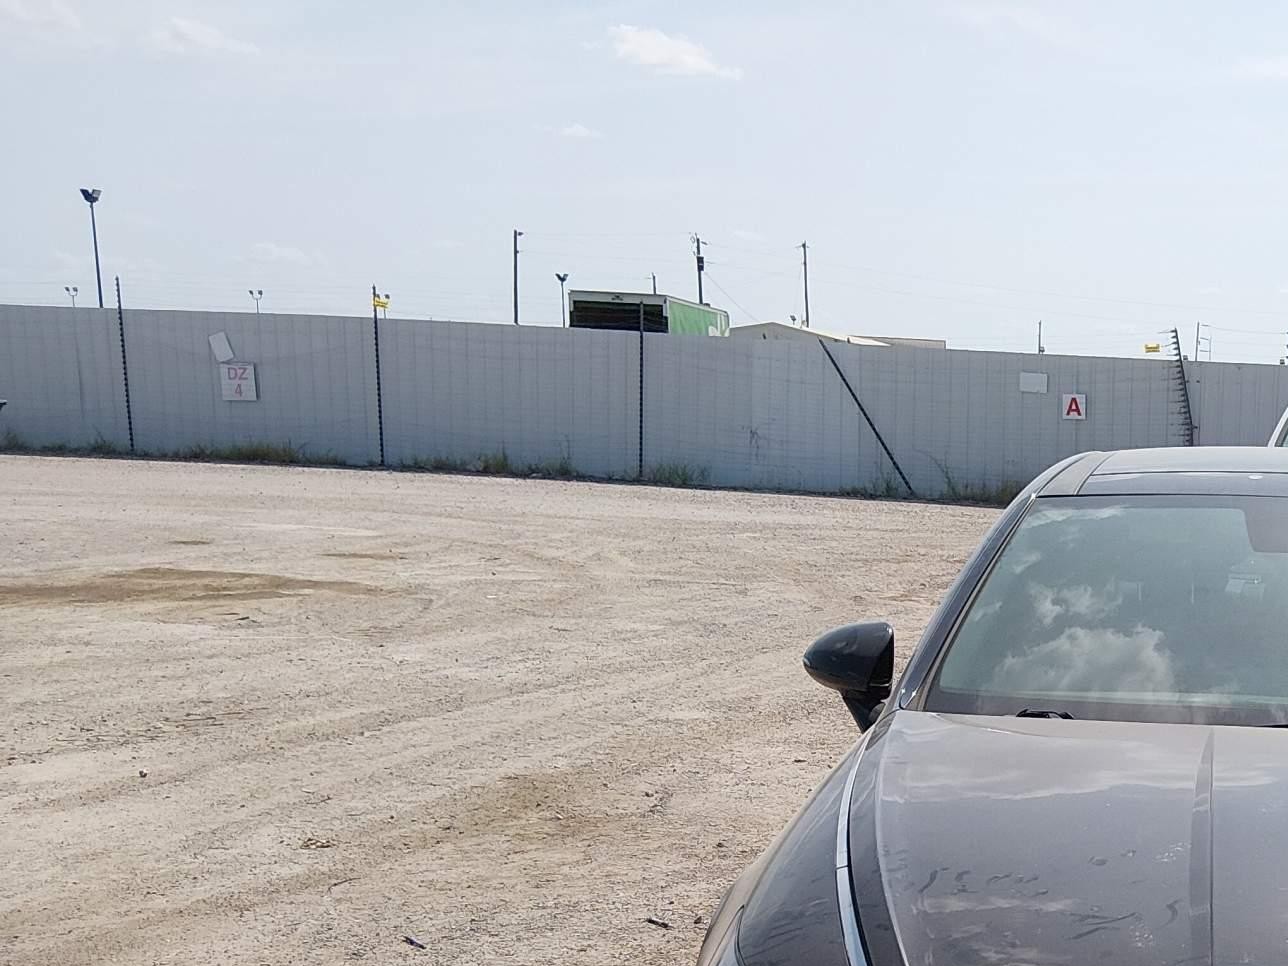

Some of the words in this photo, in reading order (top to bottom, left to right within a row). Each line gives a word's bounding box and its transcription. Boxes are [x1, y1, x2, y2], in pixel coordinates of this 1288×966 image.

[227, 367, 249, 381] DZ
[234, 383, 243, 398] 4
[1066, 397, 1082, 416] A
